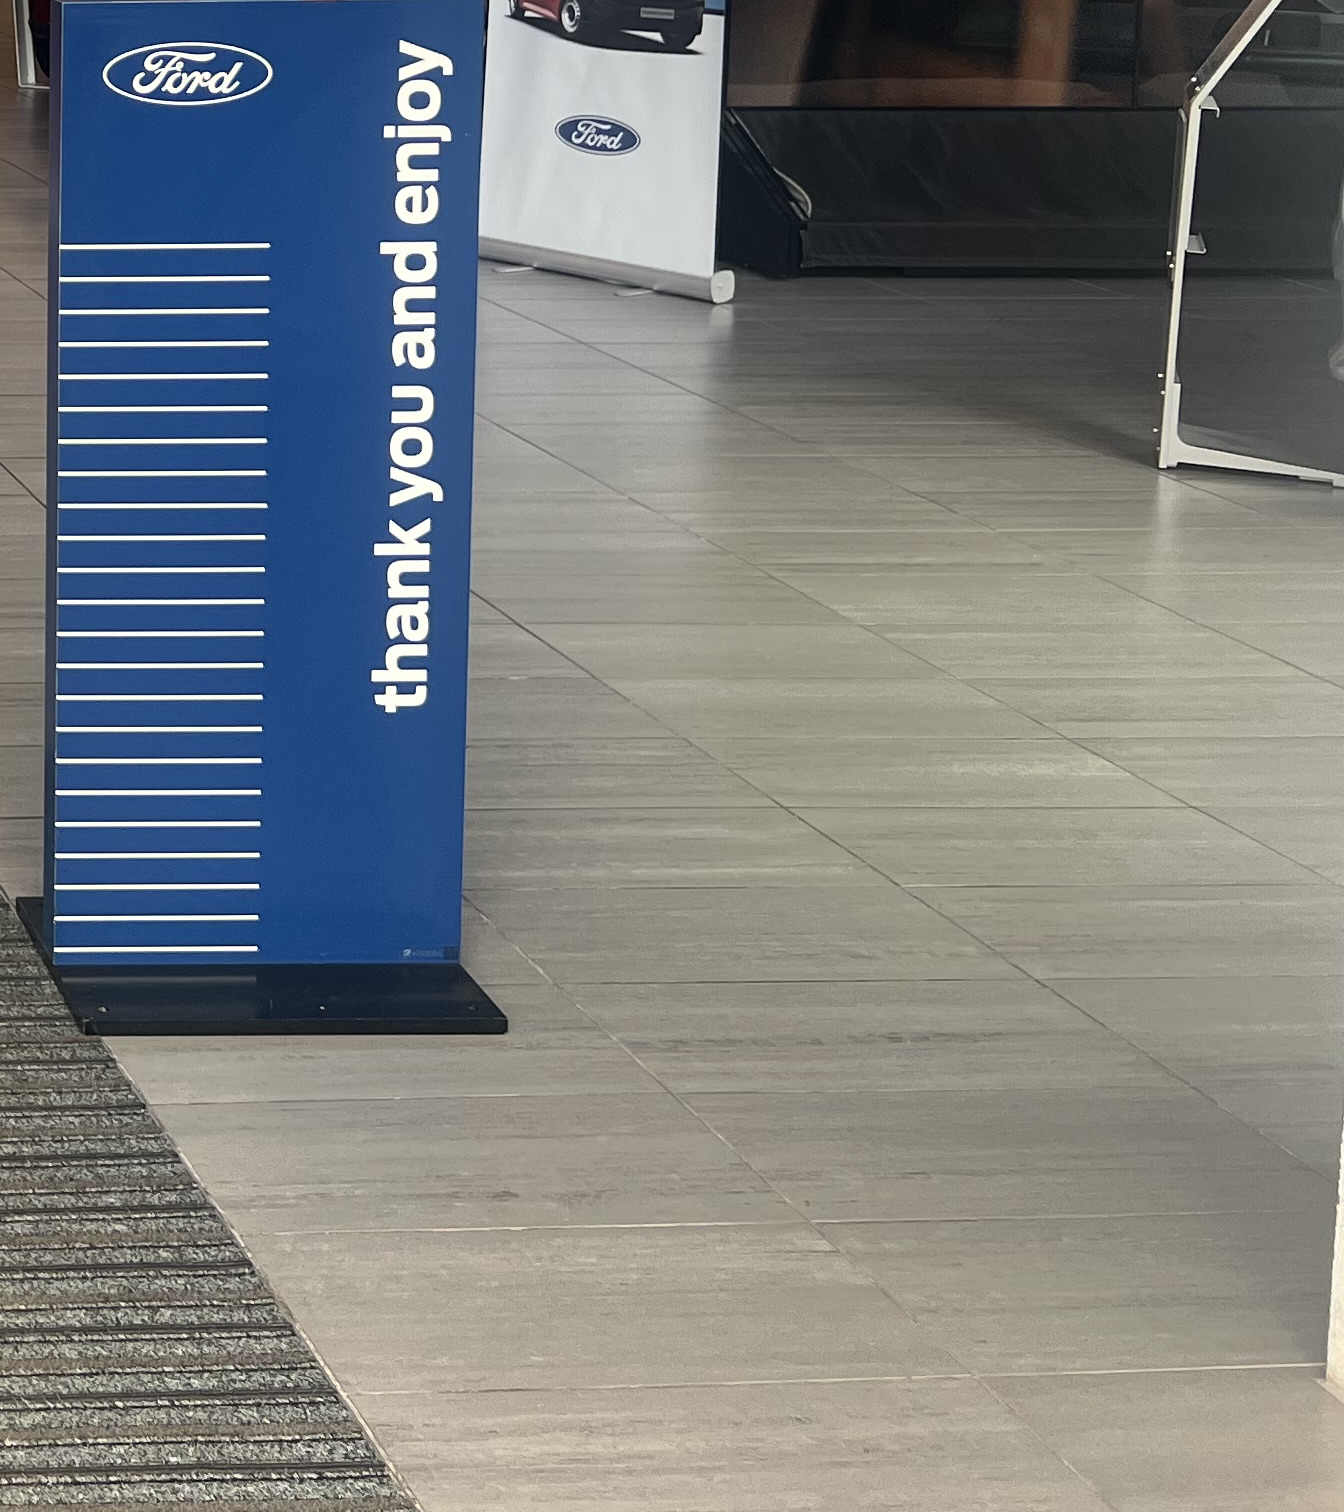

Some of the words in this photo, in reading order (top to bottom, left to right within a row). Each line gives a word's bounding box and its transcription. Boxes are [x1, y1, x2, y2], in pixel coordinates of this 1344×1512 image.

[132, 50, 240, 97] Ford
[383, 40, 454, 226] enjoy
[570, 117, 625, 151] Ford
[380, 242, 438, 369] and
[389, 385, 444, 503] you
[371, 518, 432, 714] thank
